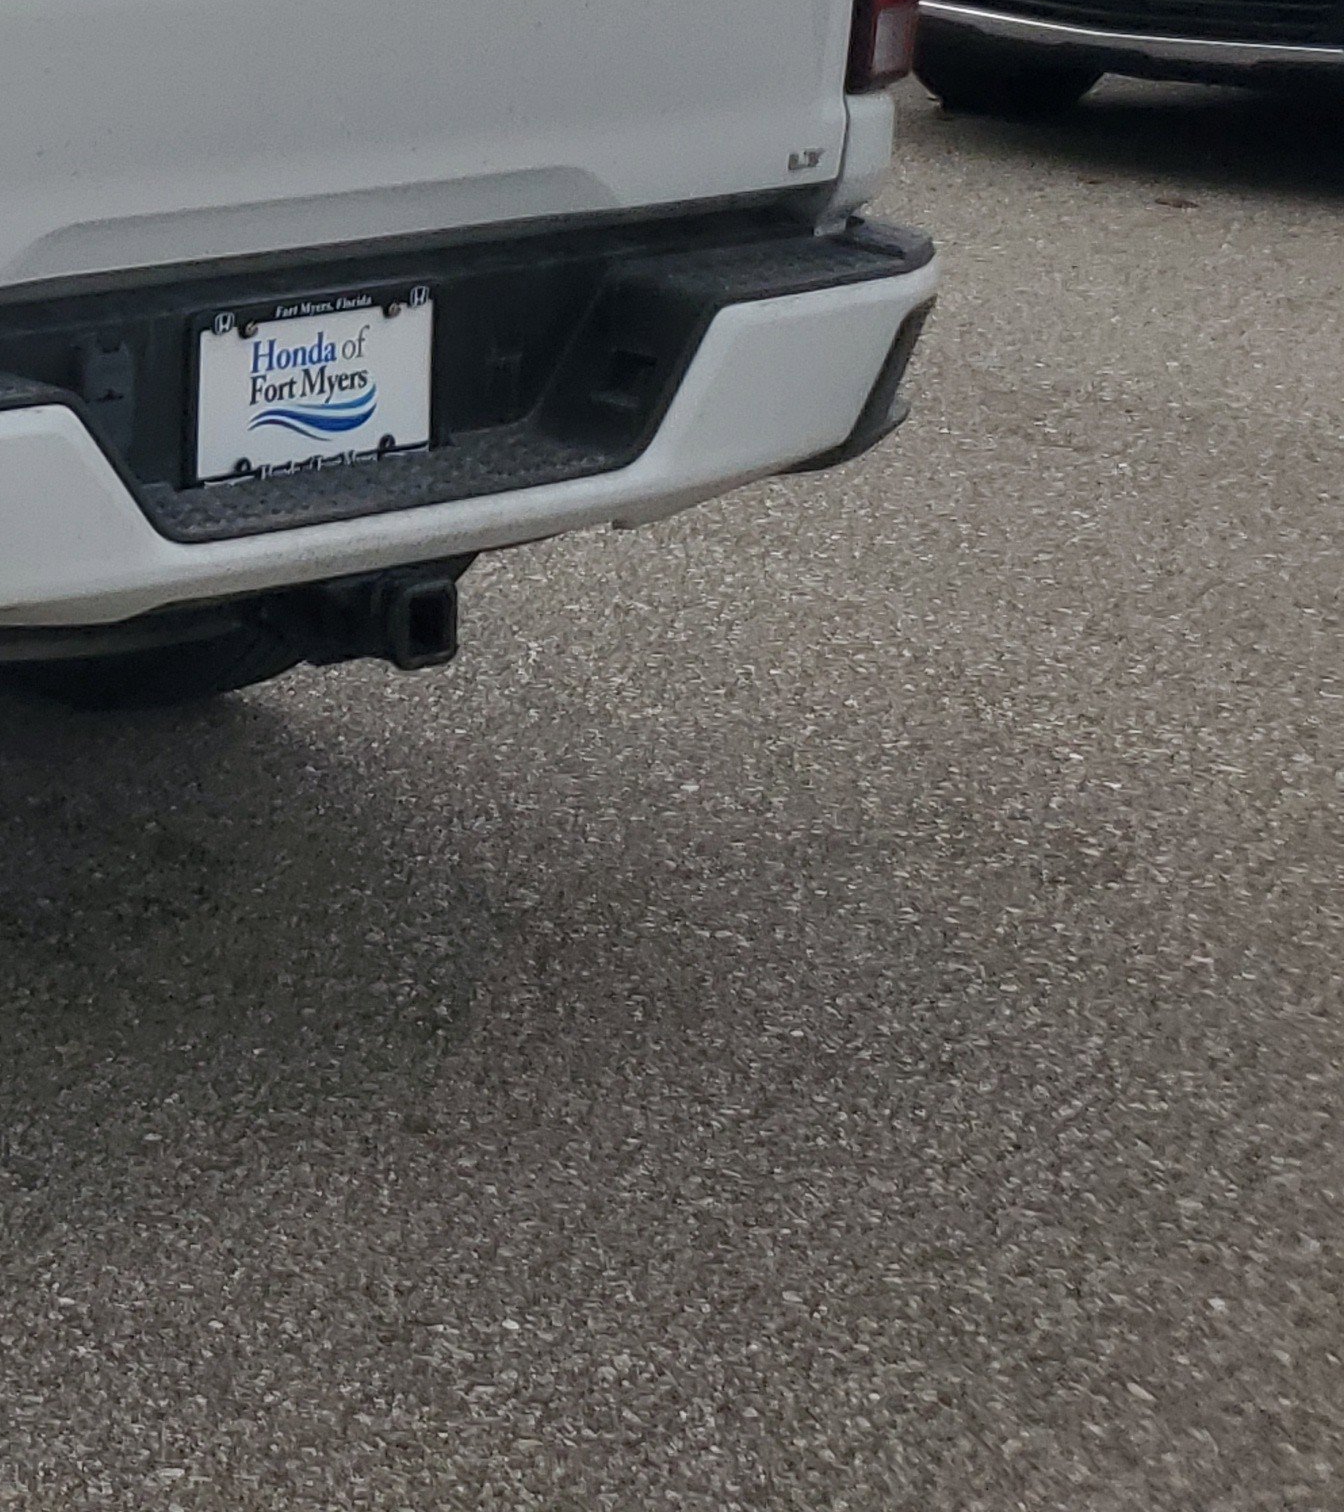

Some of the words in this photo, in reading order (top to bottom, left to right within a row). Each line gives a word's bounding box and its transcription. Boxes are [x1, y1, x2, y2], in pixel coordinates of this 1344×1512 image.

[788, 148, 825, 170] LT
[275, 305, 298, 318] Fort
[251, 332, 337, 373] Honda
[343, 325, 370, 359] of
[249, 374, 297, 406] Fort
[300, 366, 368, 403] Myers
